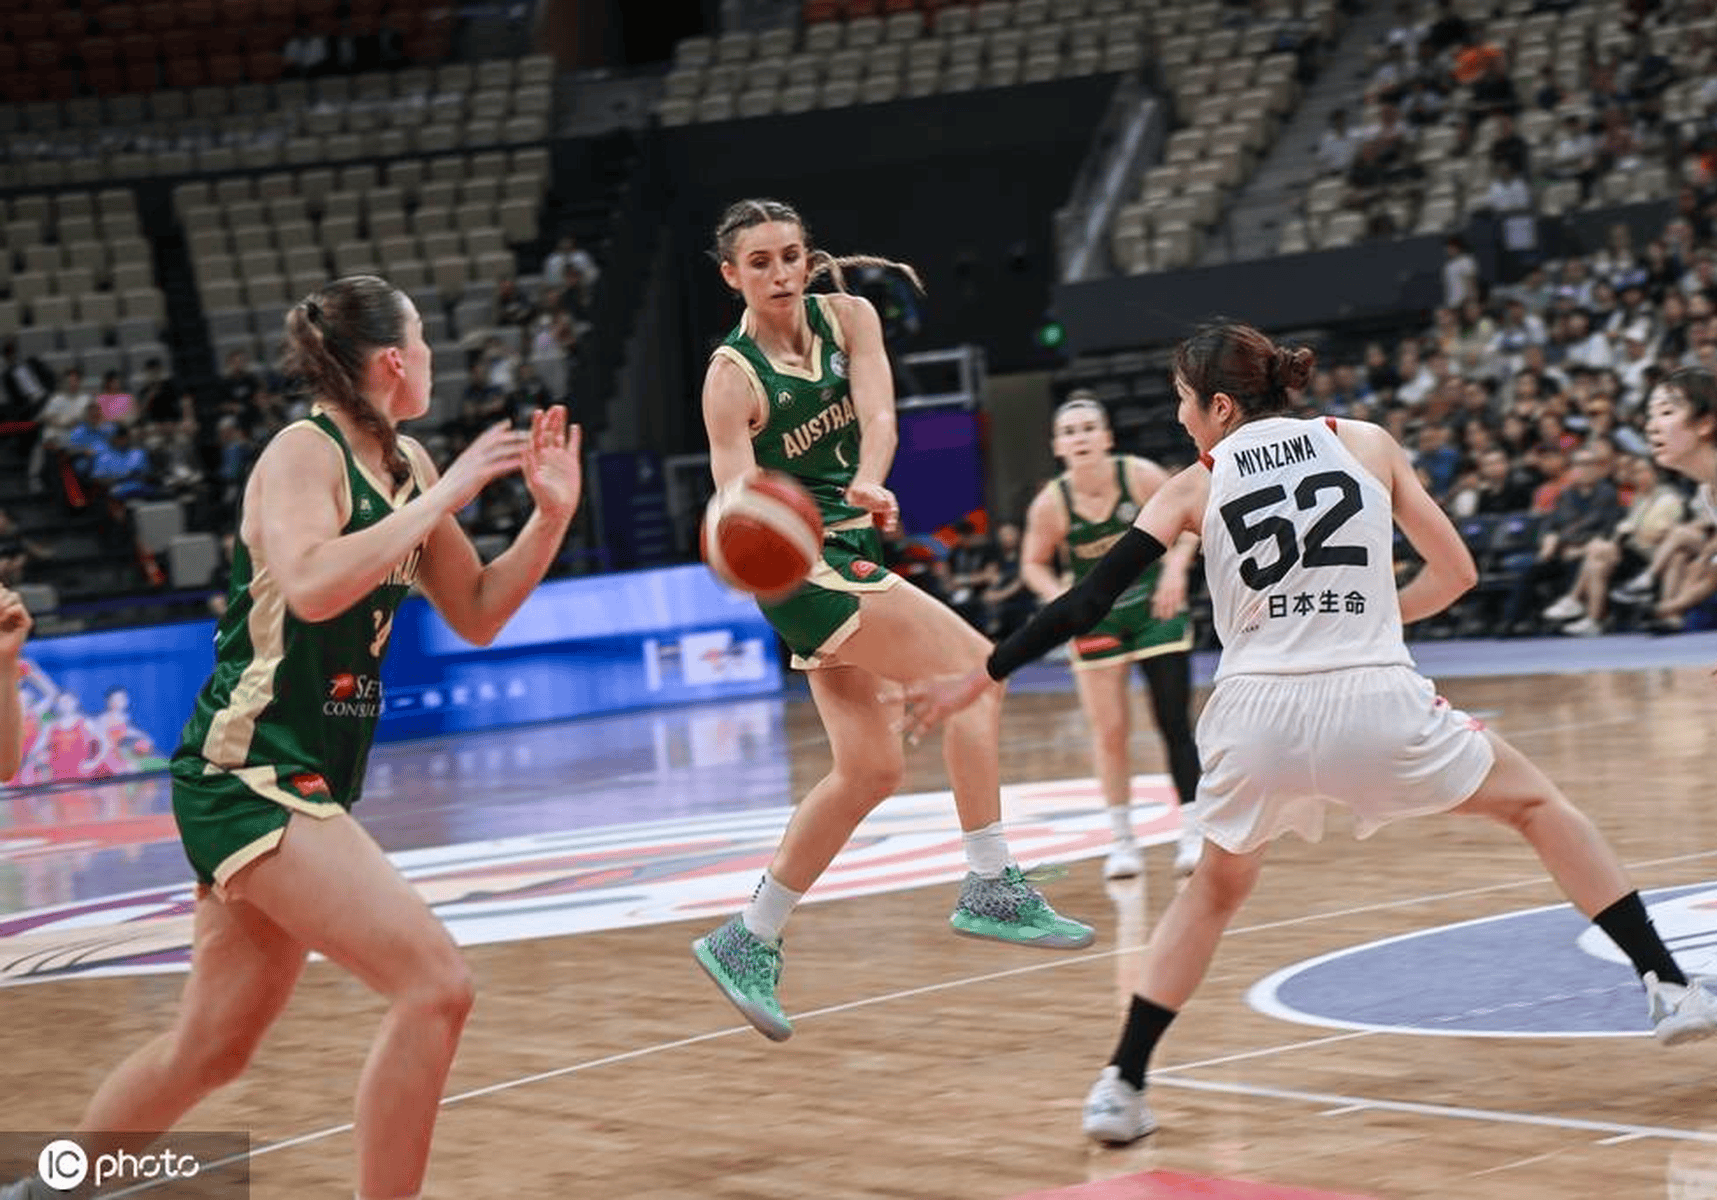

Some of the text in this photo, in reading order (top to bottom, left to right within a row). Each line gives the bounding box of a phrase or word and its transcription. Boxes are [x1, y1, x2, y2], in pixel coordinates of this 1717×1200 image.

[782, 394, 855, 459] AUSTRA
[1233, 434, 1317, 478] MIYAZAWA
[1219, 470, 1368, 591] 52
[1268, 590, 1366, 619] 日本生命
